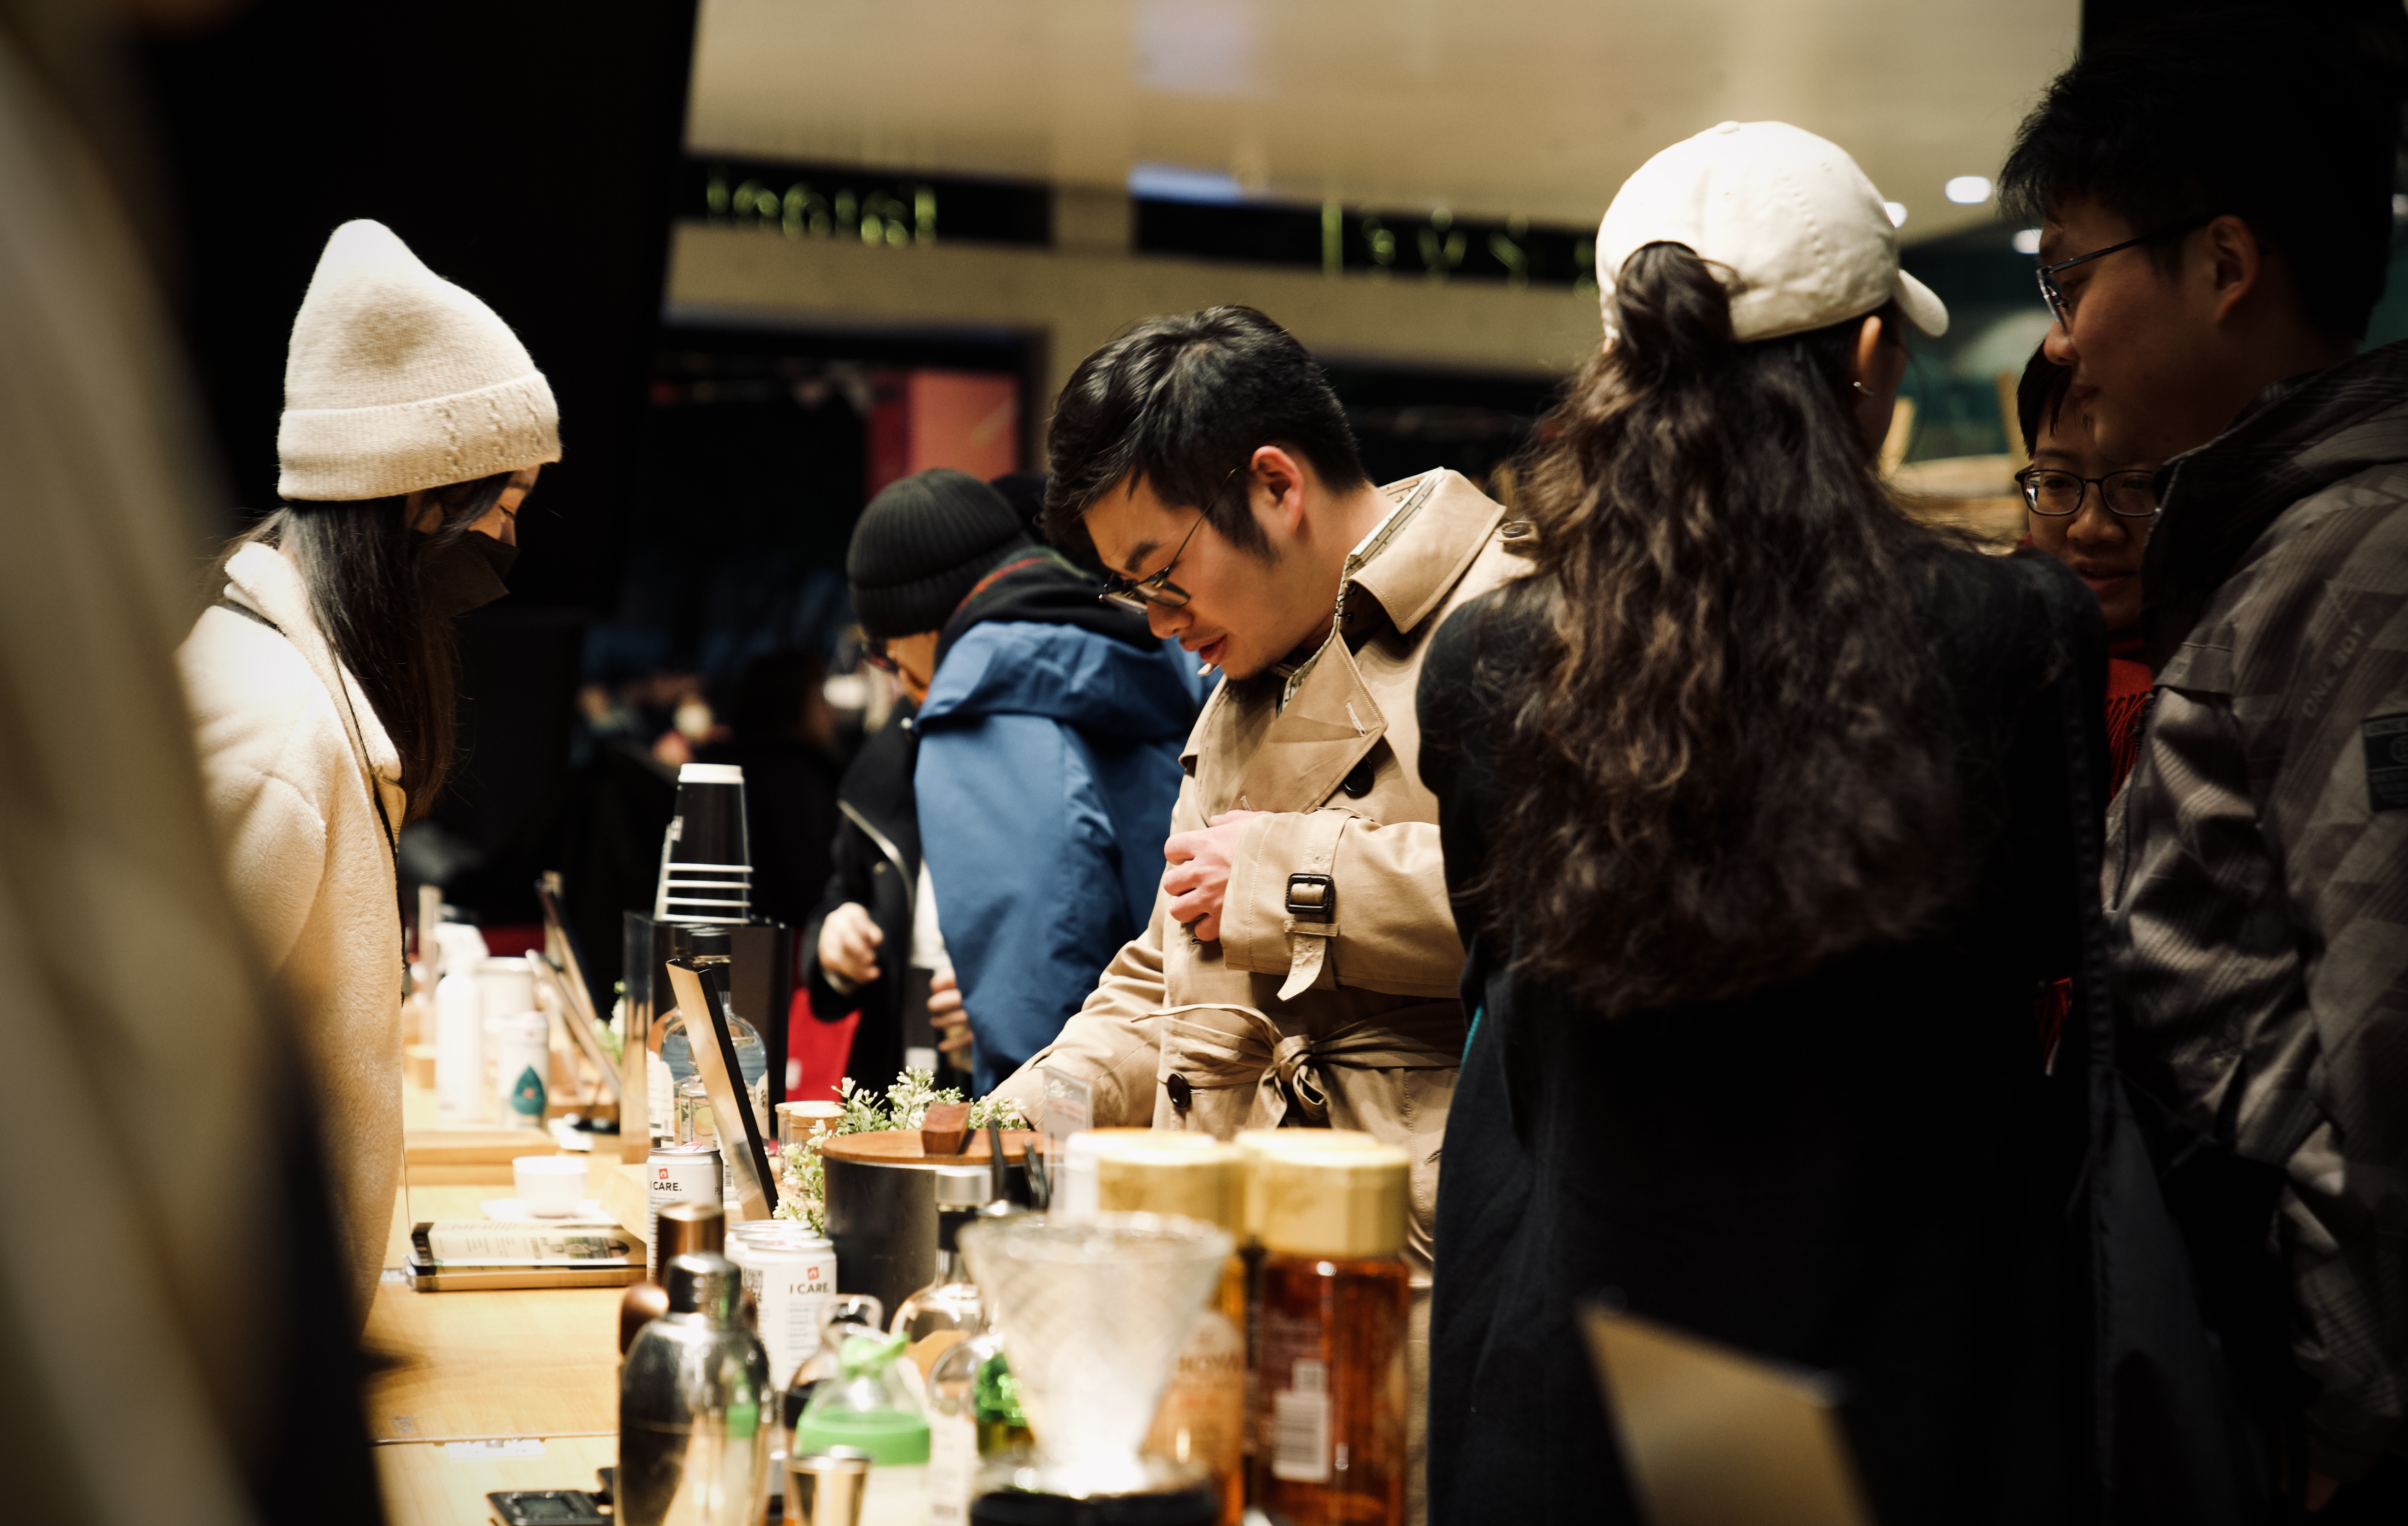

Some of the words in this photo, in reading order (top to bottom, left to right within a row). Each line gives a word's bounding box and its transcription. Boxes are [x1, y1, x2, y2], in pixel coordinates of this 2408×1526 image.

[650, 1180, 652, 1190] I
[653, 1181, 682, 1191] CARE.
[790, 1283, 793, 1294] I
